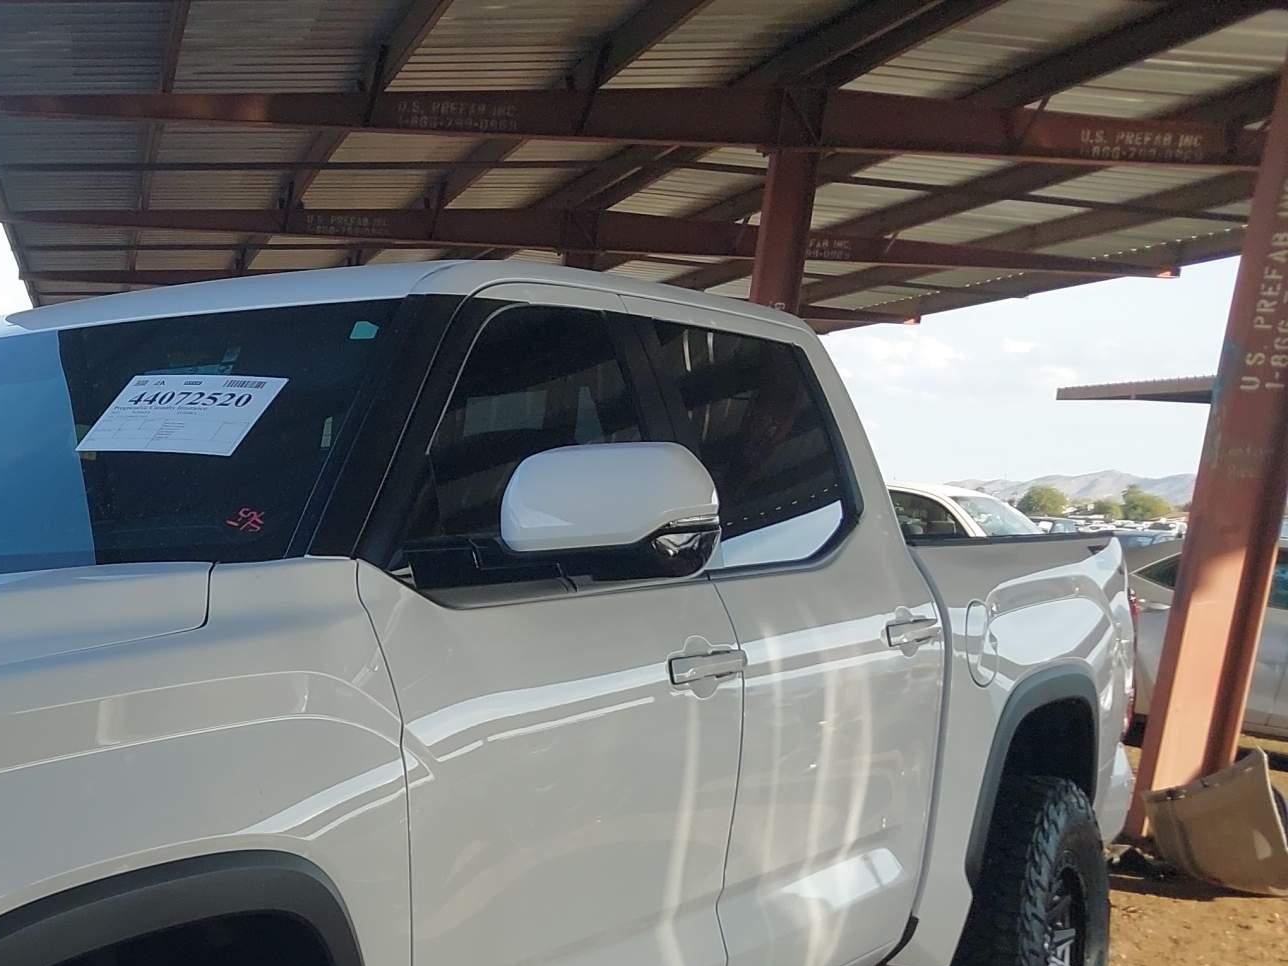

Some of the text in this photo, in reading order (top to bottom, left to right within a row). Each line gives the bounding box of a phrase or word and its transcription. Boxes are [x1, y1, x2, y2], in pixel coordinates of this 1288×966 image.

[1114, 131, 1173, 146] PREFAB
[1253, 232, 1288, 330] PREFAB
[127, 391, 253, 408] 44072520
